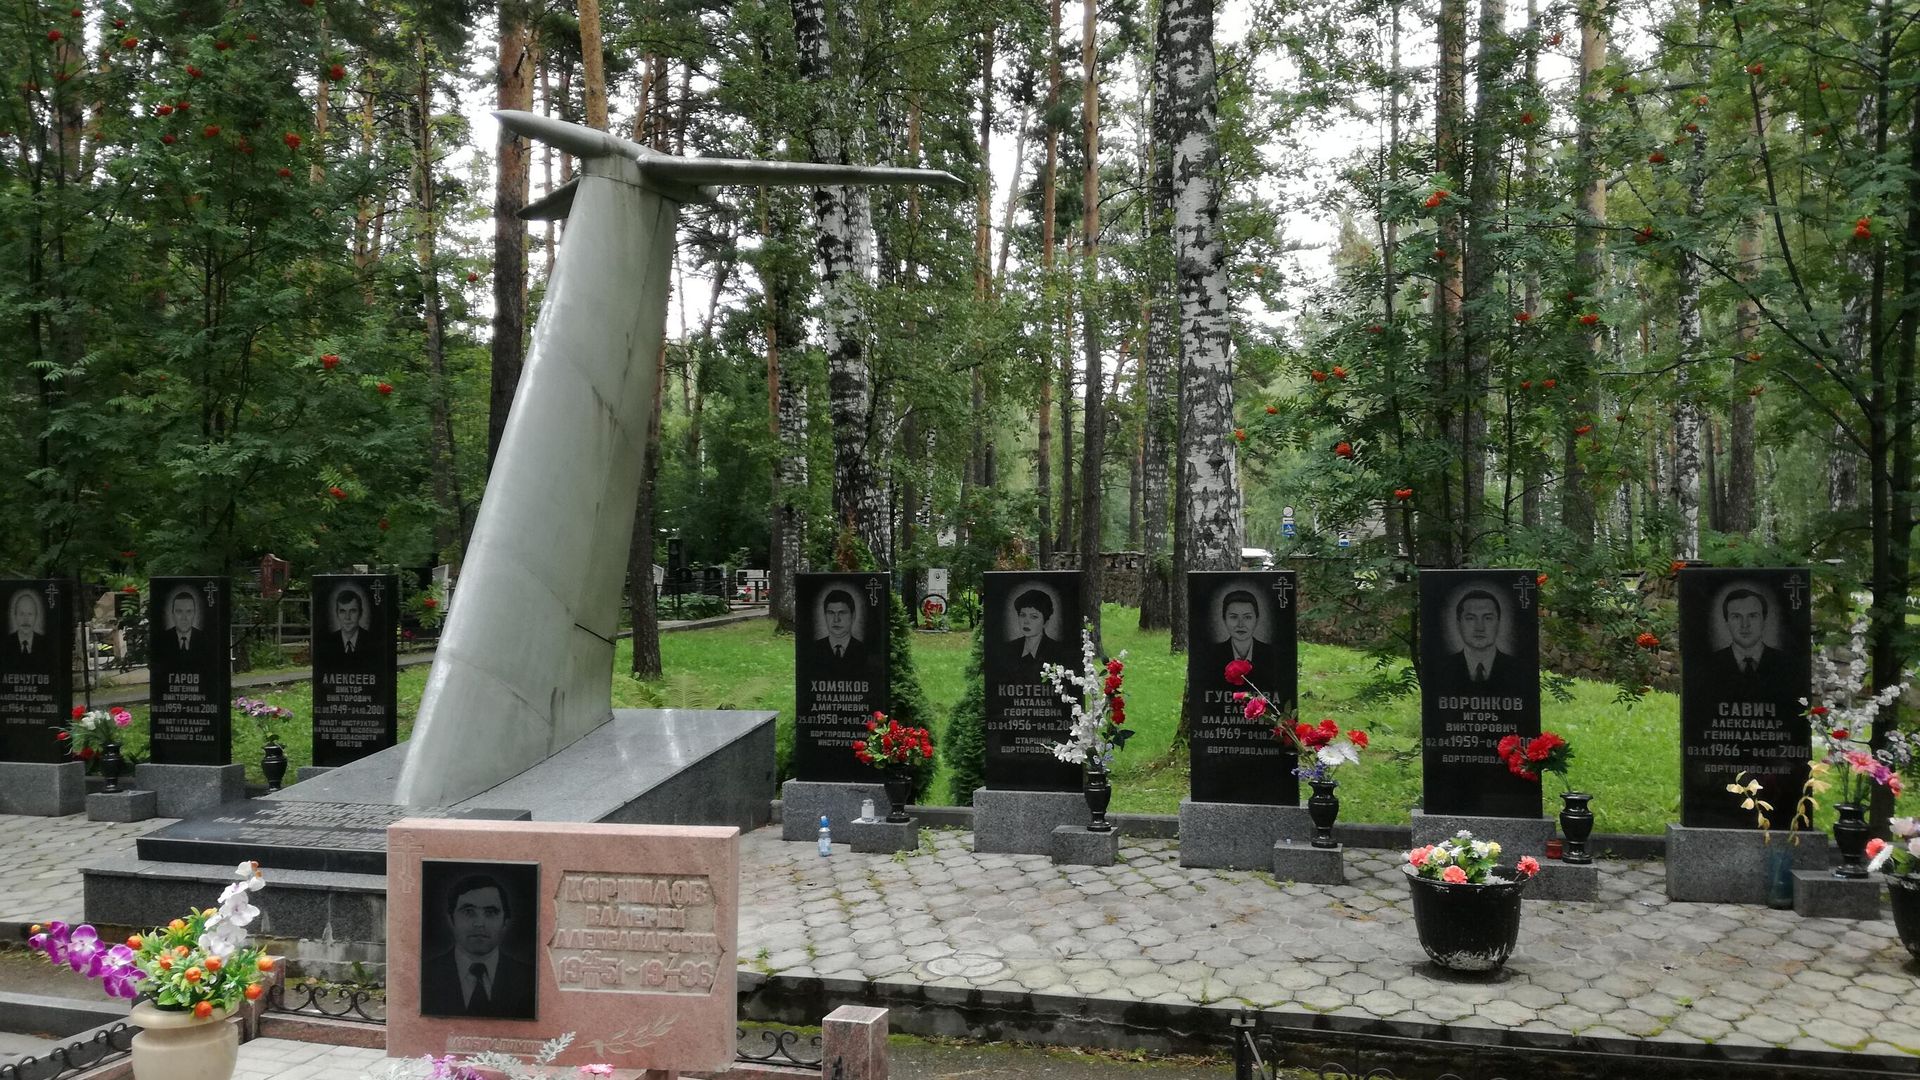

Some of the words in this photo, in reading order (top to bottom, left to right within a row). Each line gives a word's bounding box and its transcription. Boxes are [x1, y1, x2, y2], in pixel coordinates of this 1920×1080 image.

[2, 673, 50, 685] ЛЕВЧУГОВ
[168, 673, 200, 684] ГАРОВ
[322, 673, 376, 685] АЛЕКСЕЕВ
[169, 685, 199, 693] ЕВГЕНИЙ
[335, 685, 363, 694] ВИКТОР
[810, 680, 870, 693] ХОМЯКОВ
[997, 684, 1060, 697] КОСТЕН
[326, 694, 372, 703] ВИКТОРОВИЧ
[816, 693, 864, 703] ВЛАДИМИР
[1013, 698, 1053, 707] НАТАЛЬЯ
[1438, 696, 1524, 711] ВОРОНКОВ
[810, 703, 870, 712] ДМИТРИЕВИЧ
[1003, 708, 1063, 717] ГЕОРГИЕВНА
[1718, 702, 1776, 717] САВИЧ
[1463, 711, 1499, 722] ИГОРЬ
[1445, 722, 1518, 733] ВИКТОРОВИЧ
[1711, 718, 1783, 730] АЛЕКСАНДР
[1703, 730, 1791, 741] ГЕННАДЬЕВИЧ
[817, 739, 854, 747] ИНСТРУКТ
[1001, 745, 1054, 755] БОРТПРОВОД
[1207, 746, 1280, 756] БОРТПРОВОДНИК
[1442, 754, 1505, 765] БОРТПРОВОД
[1704, 763, 1791, 775] БОРТПРОВОДНИК
[564, 876, 710, 905] КОРНИЛОВ
[586, 904, 686, 930] ВАЛЕРИЙ
[553, 928, 718, 954] АЛЕКСАНДРОВИЧ
